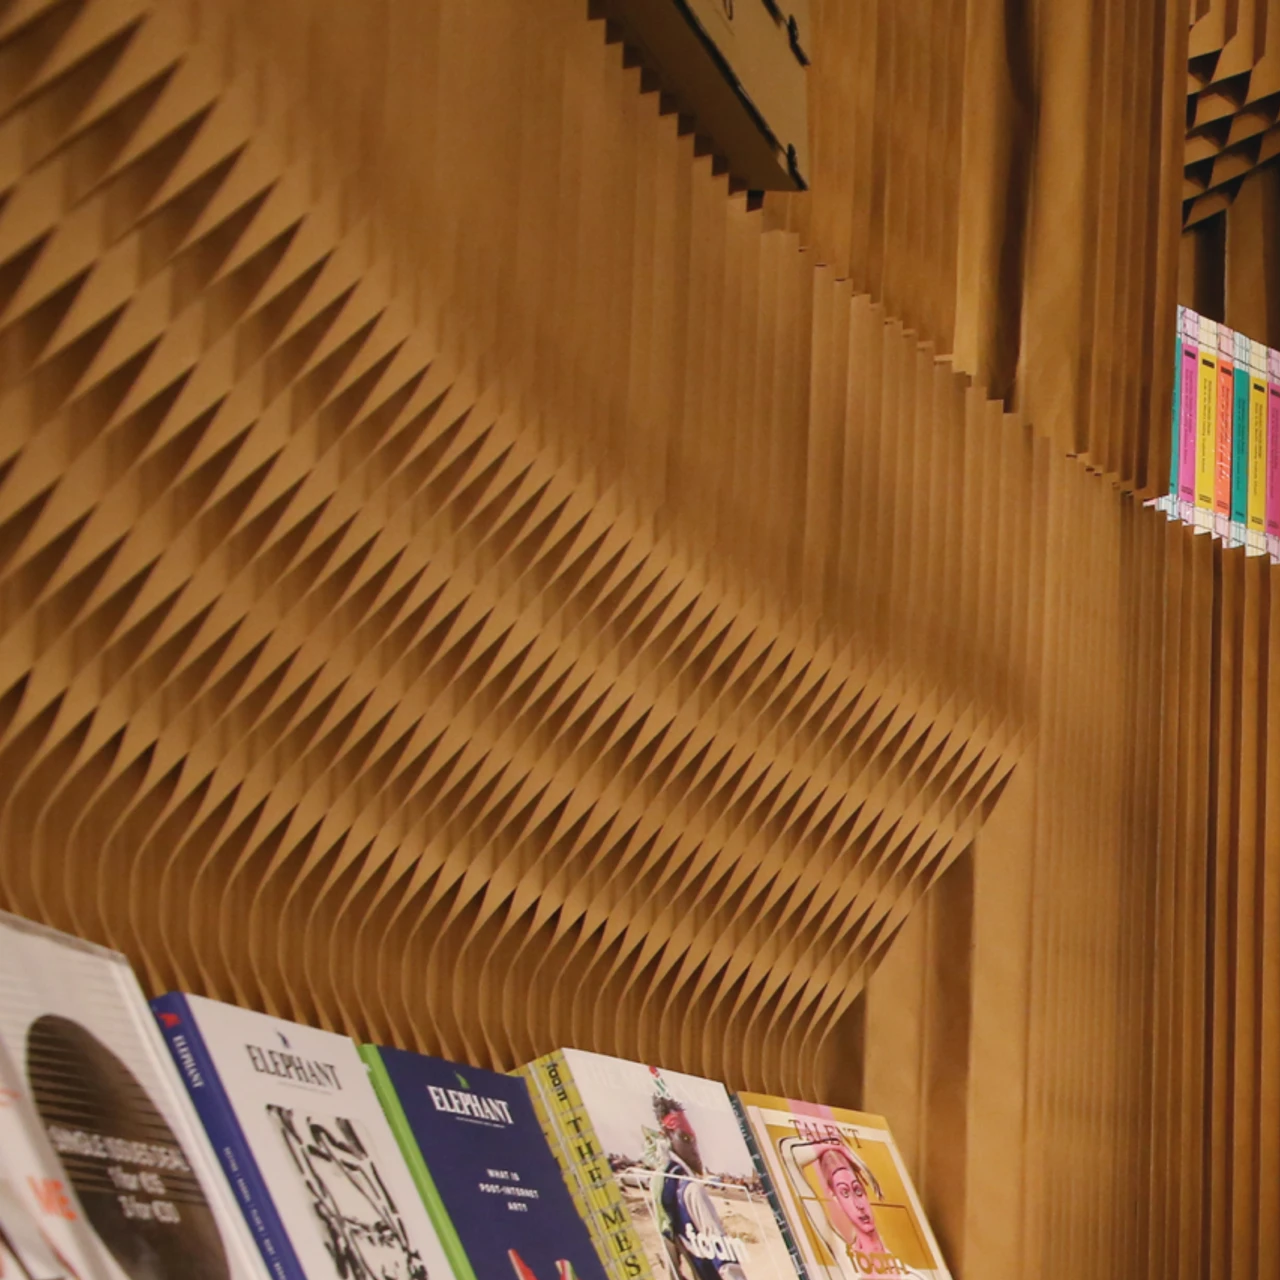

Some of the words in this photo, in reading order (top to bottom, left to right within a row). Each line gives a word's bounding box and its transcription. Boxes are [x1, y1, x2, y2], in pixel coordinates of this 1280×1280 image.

[172, 1035, 205, 1088] ELEPHANT
[245, 1044, 343, 1090] ELEPHANT
[546, 1062, 568, 1102] foam
[426, 1084, 515, 1125] ELEPHANT
[788, 1119, 863, 1149] TALENT
[486, 1168, 510, 1180] WHAT
[685, 1222, 750, 1263] foam
